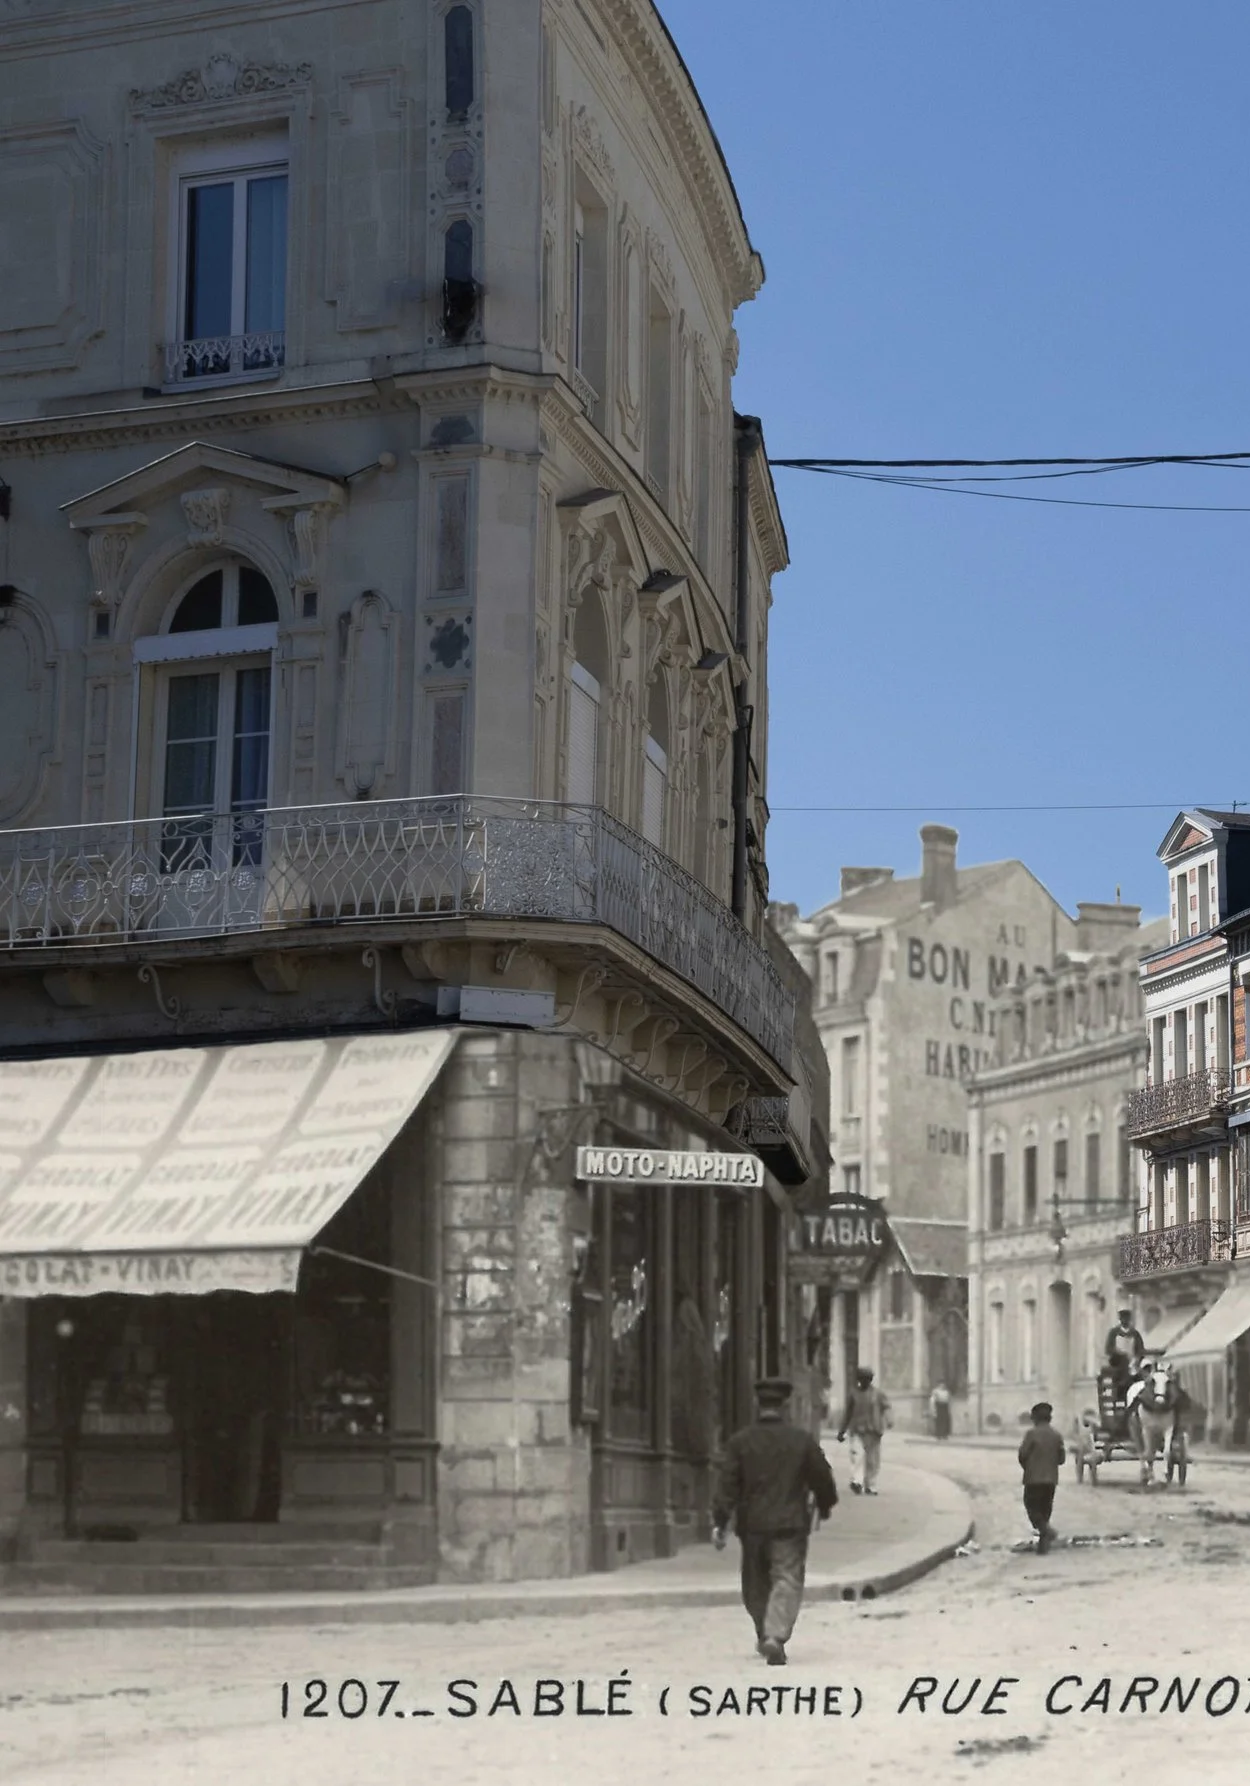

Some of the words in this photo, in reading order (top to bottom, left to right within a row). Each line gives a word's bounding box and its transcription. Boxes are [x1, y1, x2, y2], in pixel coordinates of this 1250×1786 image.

[908, 937, 970, 991] BON
[988, 954, 1046, 1000] MA
[803, 1215, 884, 1246] TABAC
